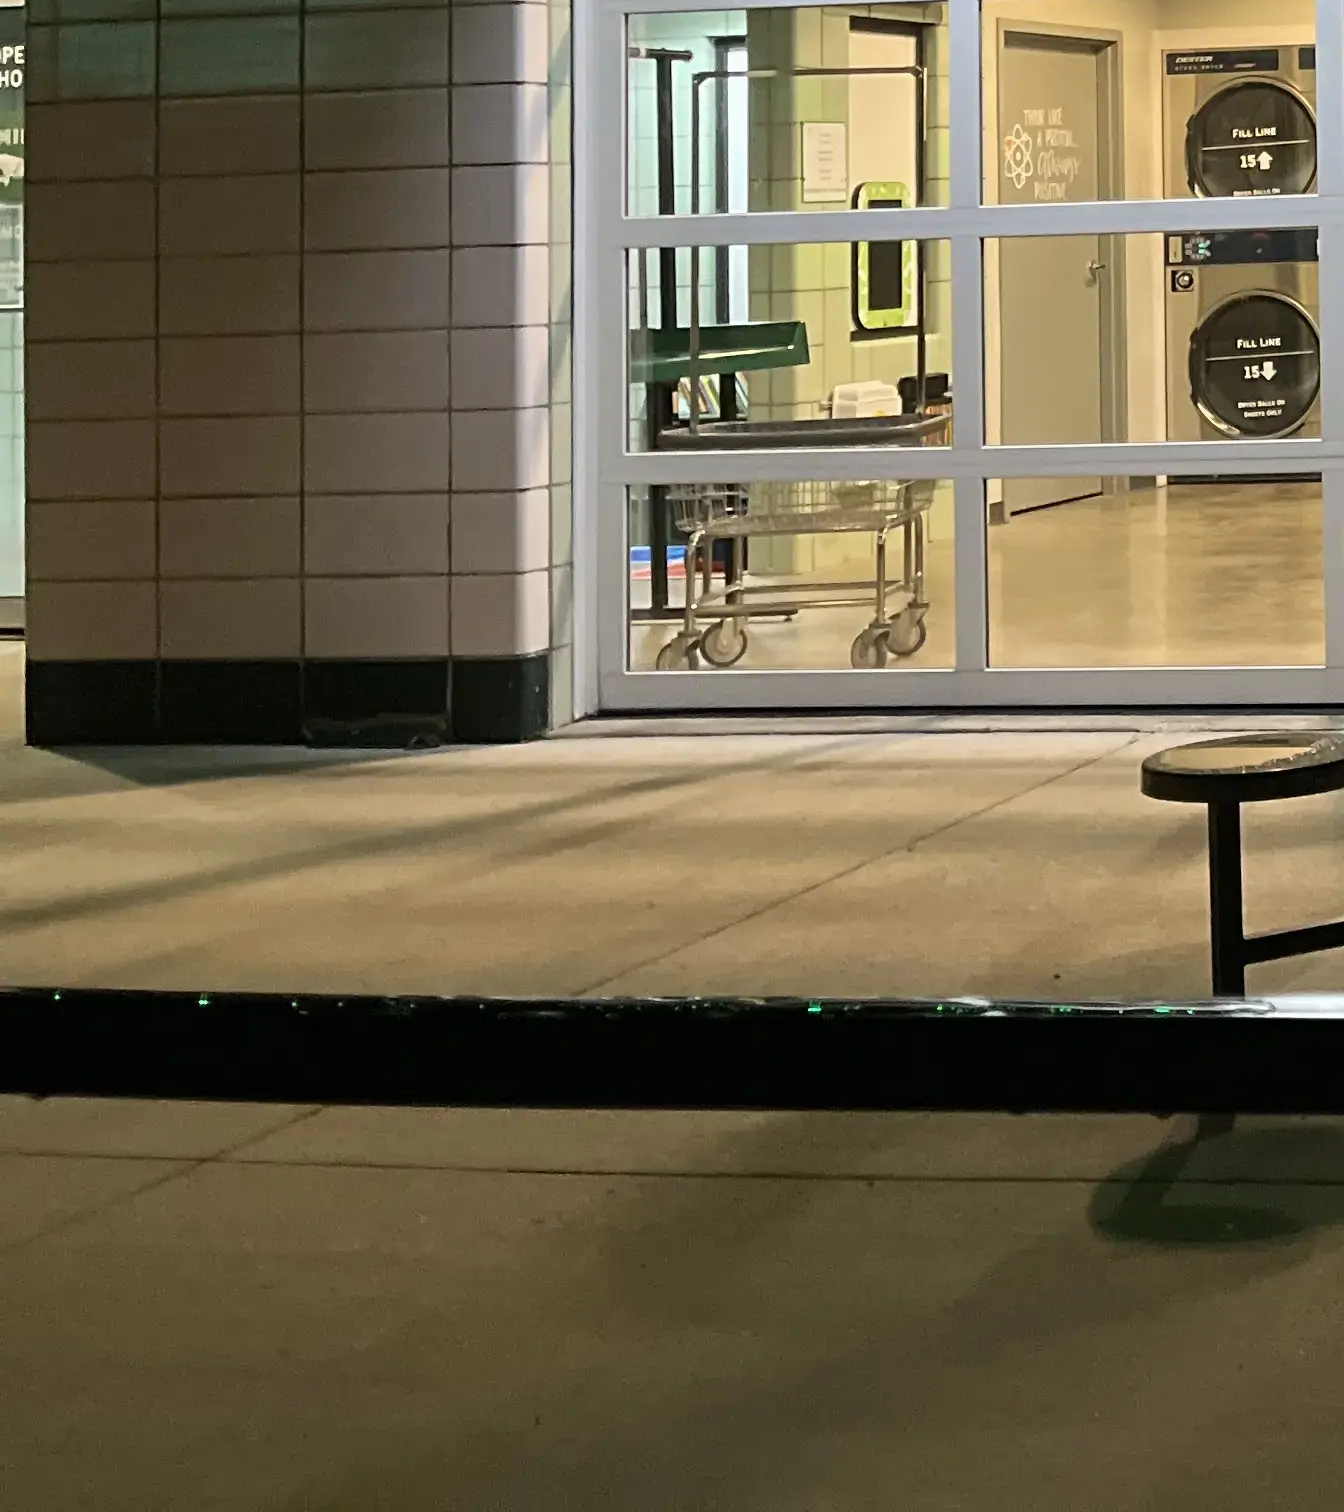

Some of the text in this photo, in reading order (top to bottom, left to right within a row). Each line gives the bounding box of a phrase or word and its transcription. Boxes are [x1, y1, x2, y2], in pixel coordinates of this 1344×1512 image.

[1174, 55, 1214, 64] DEXTER
[1232, 126, 1277, 139] FILL LINE
[1240, 154, 1257, 169] 15
[1236, 337, 1282, 349] FILL LINE
[1243, 364, 1260, 379] 15
